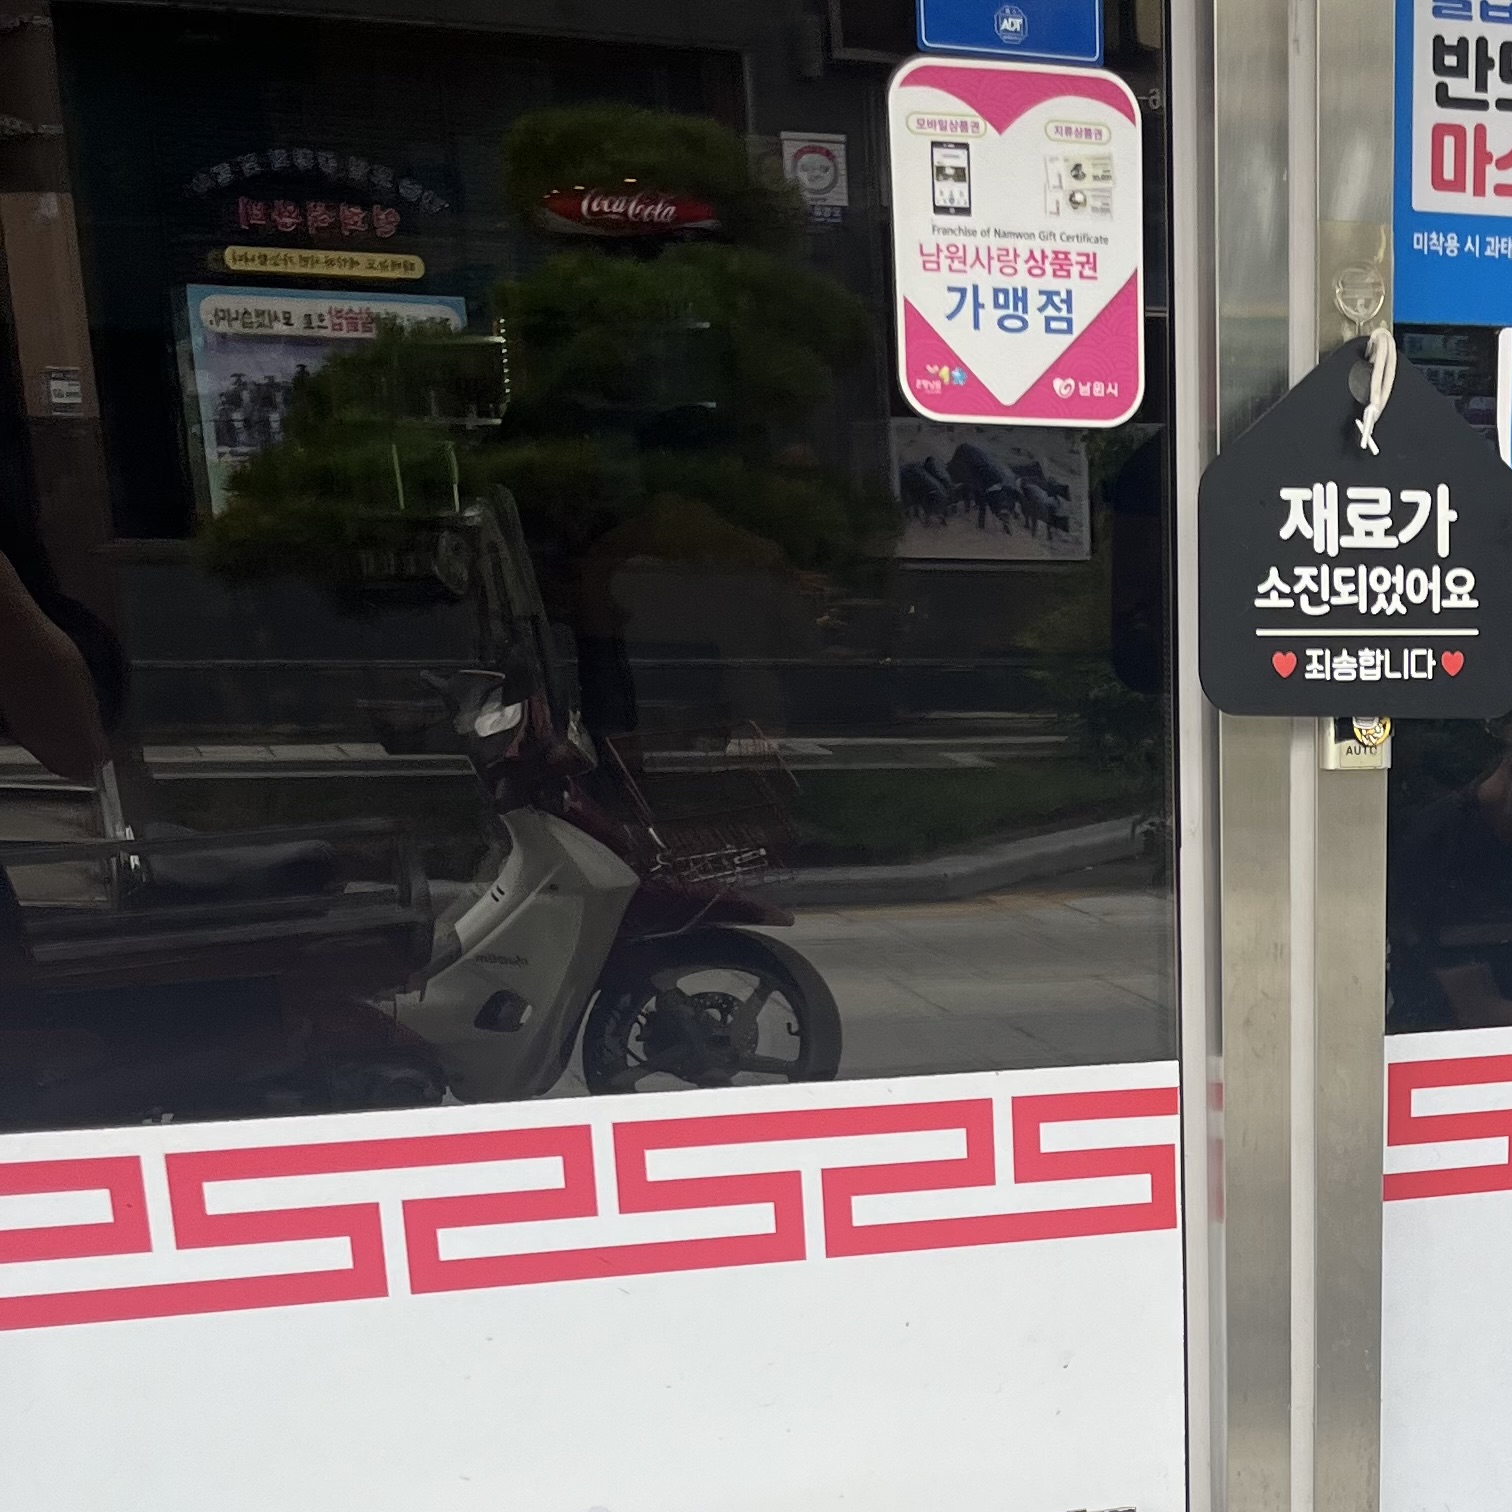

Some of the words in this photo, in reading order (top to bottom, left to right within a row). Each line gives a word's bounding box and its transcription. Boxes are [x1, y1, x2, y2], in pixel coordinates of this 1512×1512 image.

[1000, 18, 1023, 31] ADT
[916, 117, 980, 134] 모바일상품권
[931, 226, 978, 237] Franchise
[980, 226, 991, 237] of
[994, 229, 1035, 240] Namwon
[1039, 231, 1057, 242] Gift
[1059, 232, 1109, 245] Certificate
[1413, 231, 1460, 256] 미착용
[1464, 234, 1480, 257] 시
[946, 284, 1075, 335] 가맹점
[1078, 381, 1119, 398] 남원시
[1278, 481, 1459, 558] 재료가
[1254, 565, 1479, 617] 소진되었어요
[1304, 648, 1437, 681] 죄송합니다
[1345, 744, 1379, 757] AUTO
